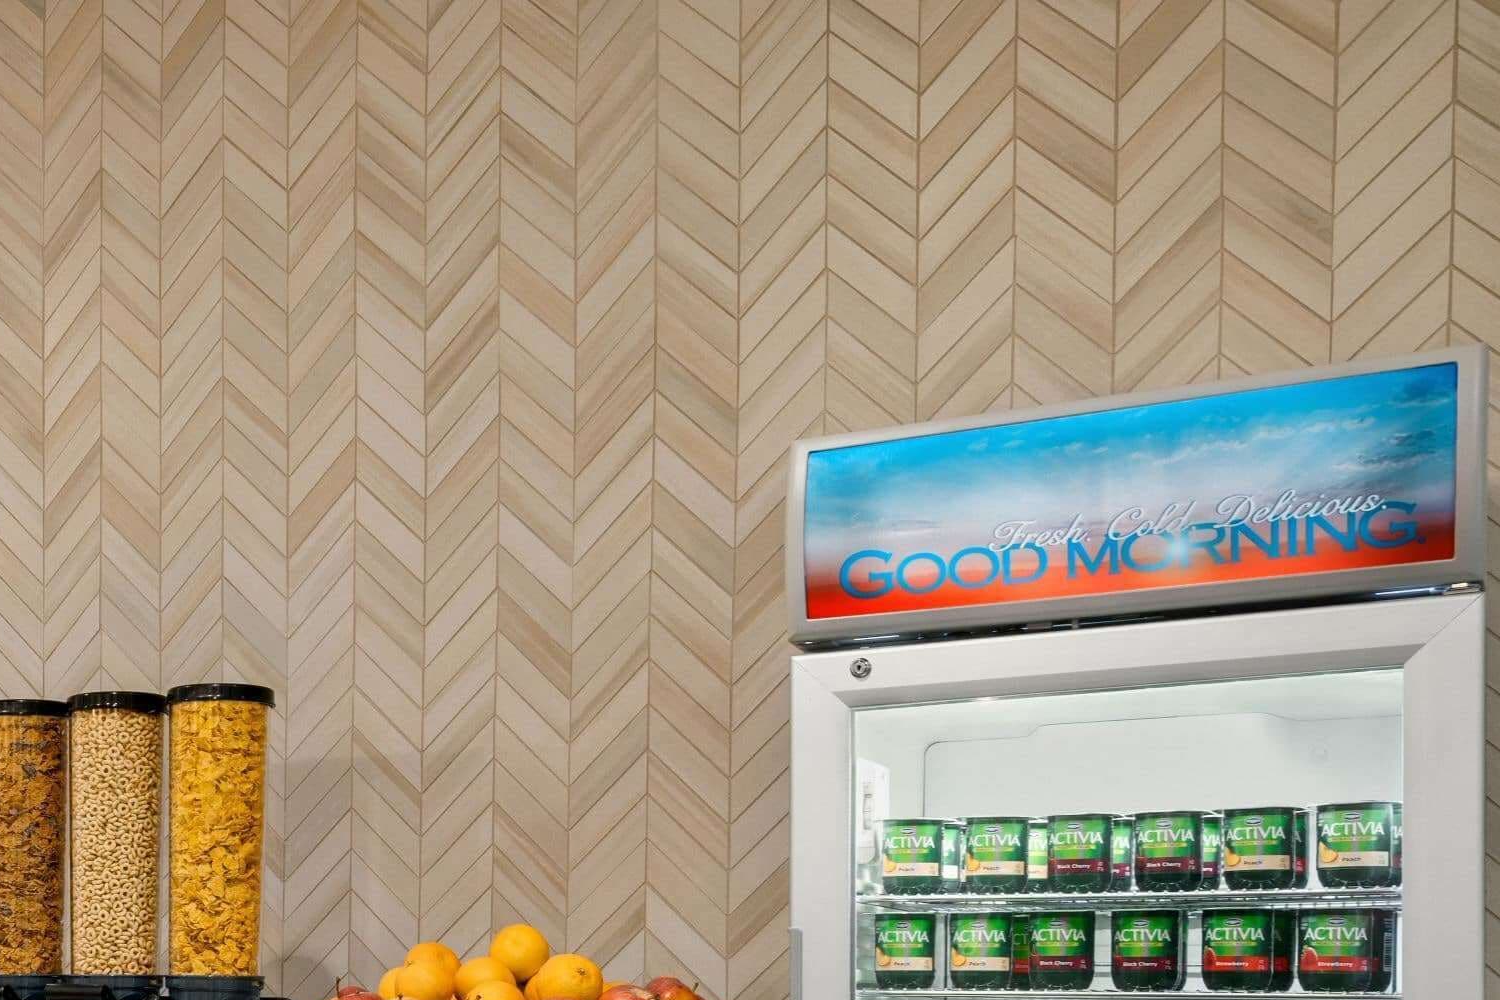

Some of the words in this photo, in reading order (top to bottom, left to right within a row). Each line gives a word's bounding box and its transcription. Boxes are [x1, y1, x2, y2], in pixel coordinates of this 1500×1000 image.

[989, 511, 1092, 552] Fresh.
[1213, 489, 1388, 530] Delicious.
[839, 542, 1049, 600] GOOD
[1138, 828, 1196, 844] ACTIVIA
[1226, 825, 1286, 841] ACTIVIA
[1321, 821, 1386, 837] ACTIVIA
[883, 835, 936, 850] ACTIVIA
[968, 832, 1021, 848] ACTIVIA
[1050, 831, 1104, 845] ACTIVIA
[877, 929, 931, 943] ACTIVIA
[952, 929, 1007, 943] ACTIVIA
[1031, 928, 1086, 942] ACTIVIA
[1114, 928, 1172, 942] ACTIVIA
[1205, 927, 1266, 941] ACTIVIA
[1303, 926, 1368, 941] ACTIVIA
